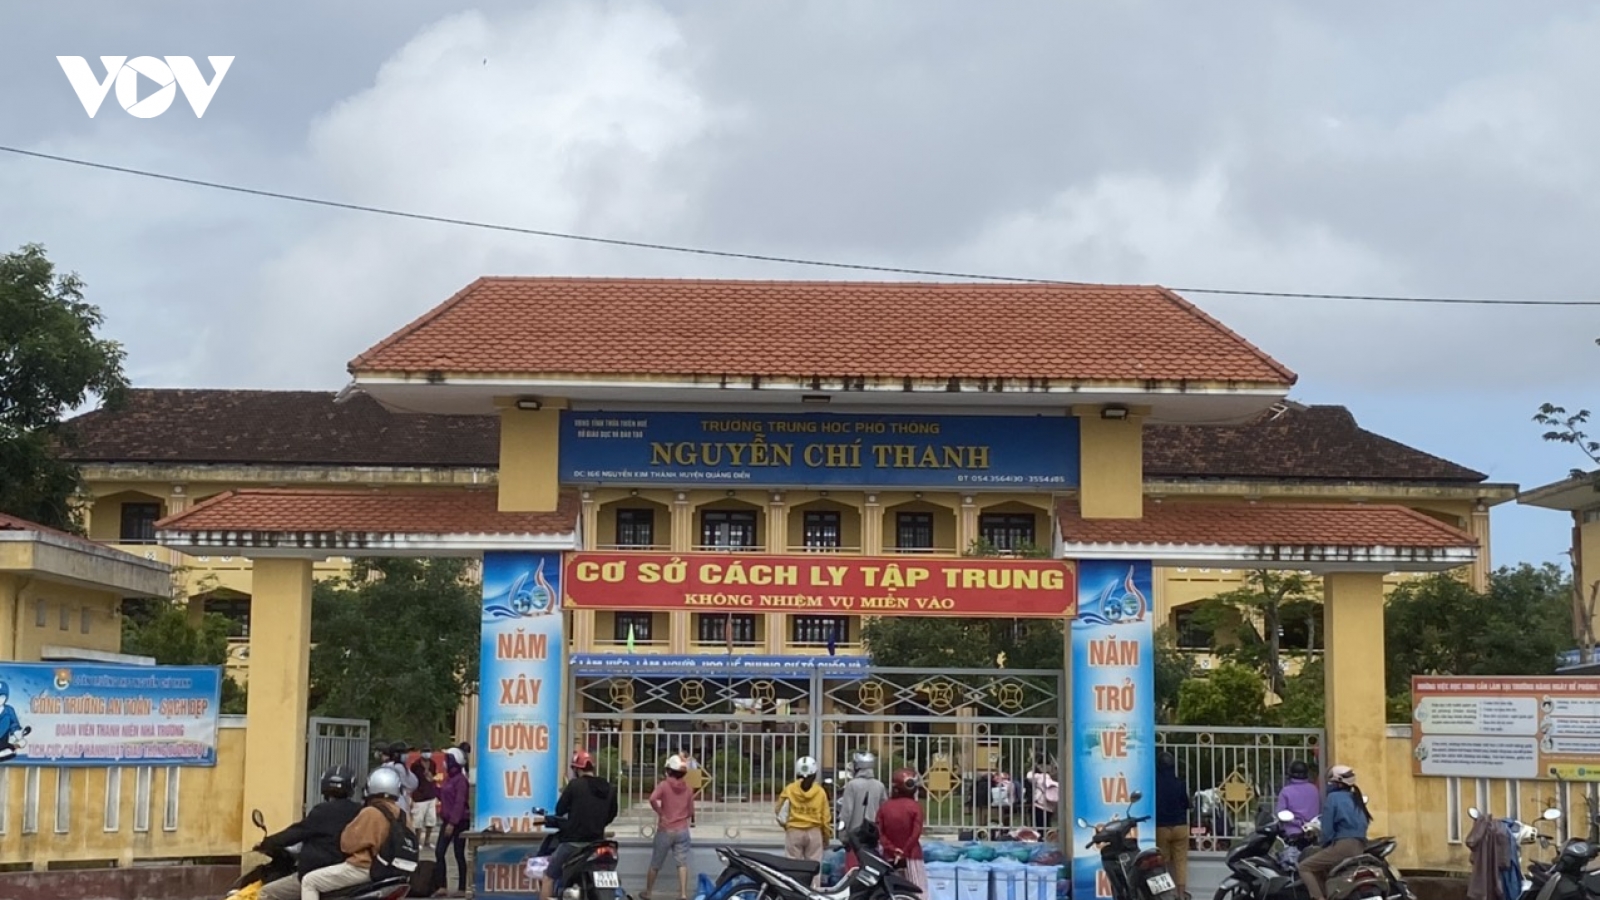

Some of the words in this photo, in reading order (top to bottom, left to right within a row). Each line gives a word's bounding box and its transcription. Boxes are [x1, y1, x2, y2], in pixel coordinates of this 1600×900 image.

[768, 421, 817, 432] TRUNG
[651, 433, 793, 467] NGUYỄN
[804, 438, 862, 467] CHÍ
[872, 445, 990, 468] THANH
[576, 560, 627, 583] CƠ
[638, 556, 688, 584] SỞ
[699, 560, 798, 586] CÁCH
[811, 565, 849, 587] LY
[860, 563, 930, 592] TẬP
[942, 568, 1064, 590] TRUNG
[685, 593, 754, 606] KHÔNG
[829, 596, 854, 609] VỤ
[916, 596, 955, 610] VÀO
[497, 627, 548, 659] NĂM
[1089, 634, 1139, 666] NĂM
[500, 673, 542, 704] XÂY
[1095, 677, 1135, 712] TRỞ
[490, 722, 549, 755] DỰNG
[1102, 723, 1127, 757] VỀ
[505, 765, 532, 797] VÀ
[1102, 772, 1130, 803] VÀ
